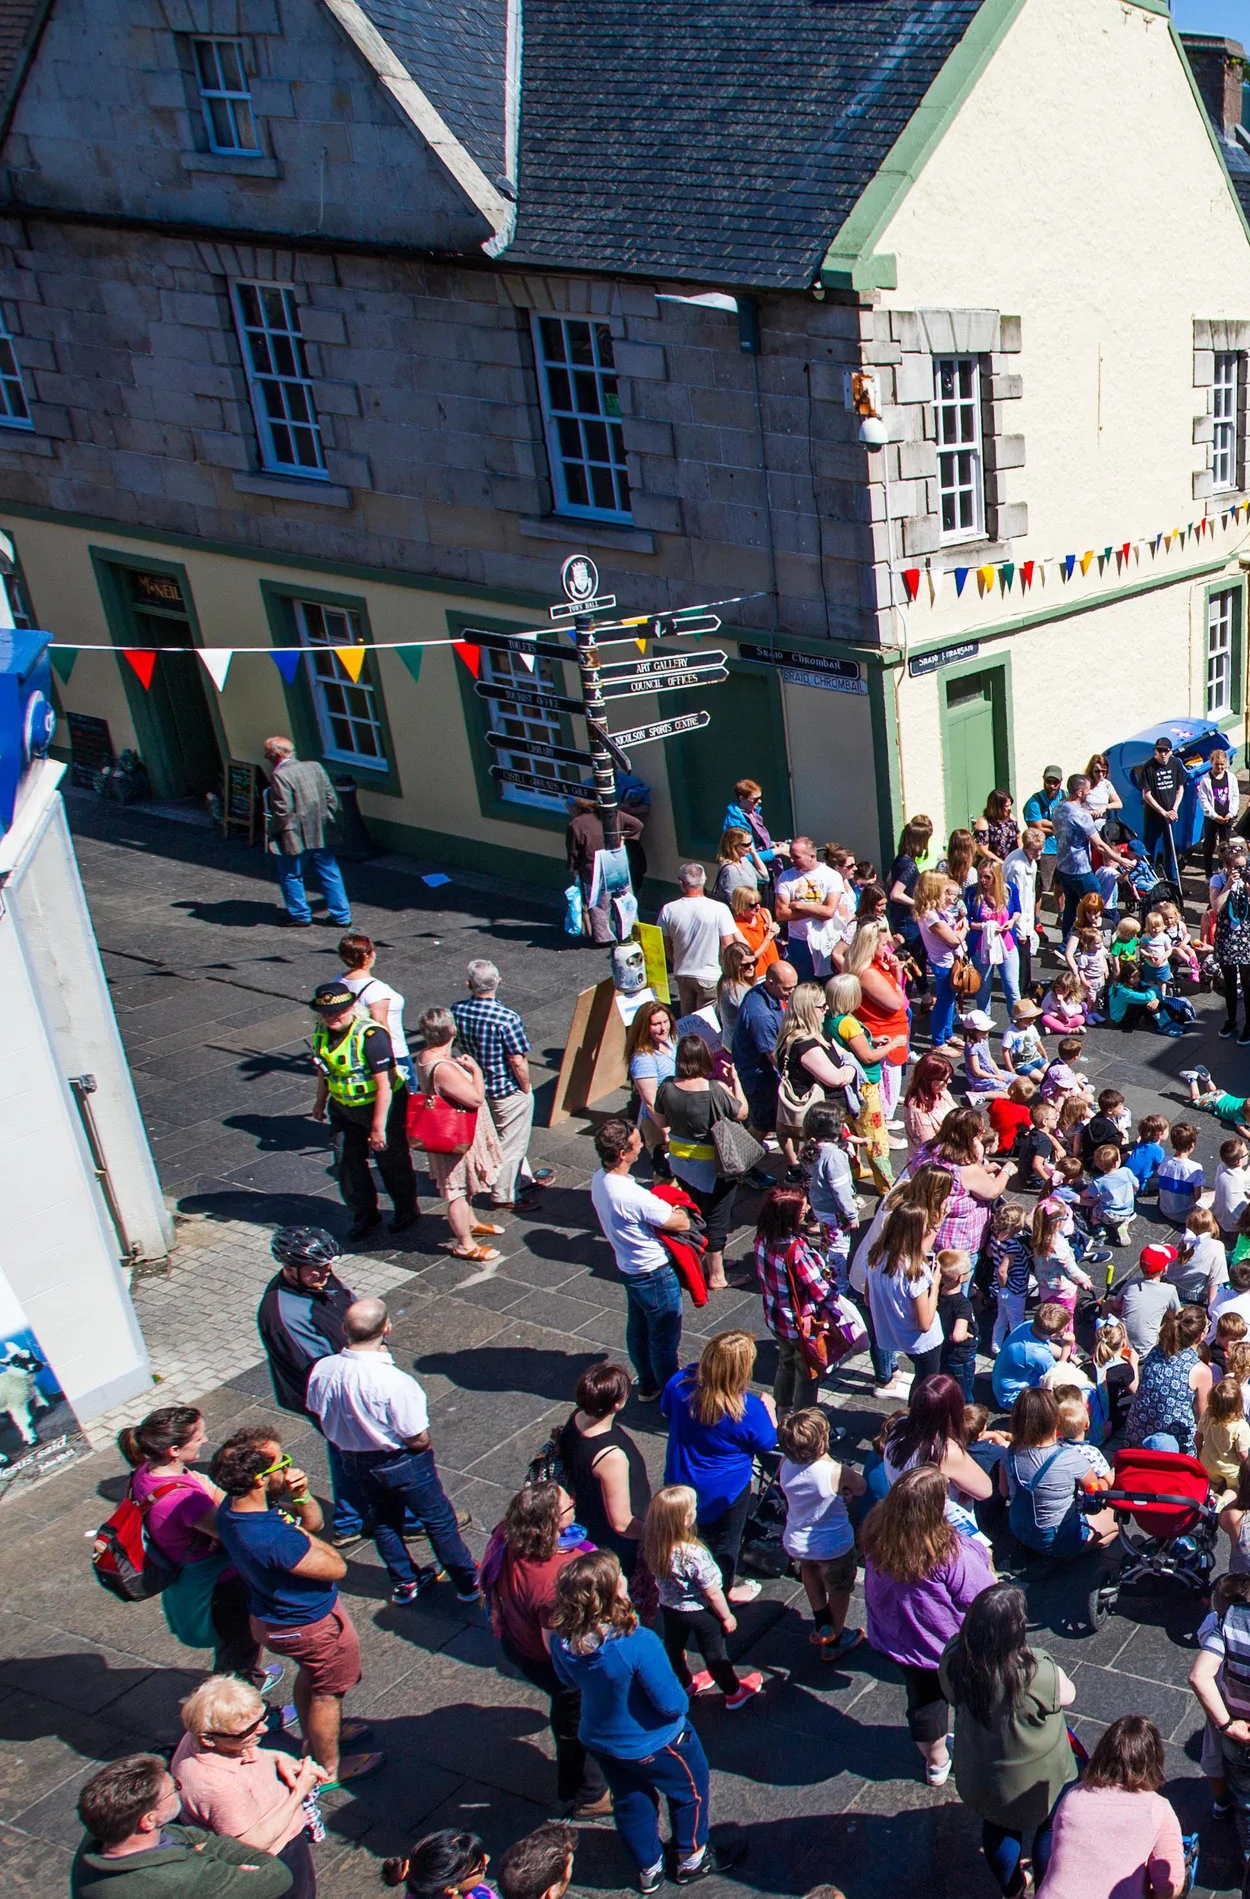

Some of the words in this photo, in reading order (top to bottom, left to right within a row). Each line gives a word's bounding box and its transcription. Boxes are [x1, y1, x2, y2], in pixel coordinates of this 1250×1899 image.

[508, 640, 537, 653] TOILETS
[636, 662, 651, 674] ART
[653, 658, 688, 671] GALLERY
[630, 679, 664, 692] COUNCIL
[667, 673, 698, 687] OFFICES
[814, 675, 865, 693] CHROMBAIL
[505, 690, 533, 704] TOURIST
[614, 731, 646, 746] NICOLSON
[649, 723, 672, 737] SPORTS
[675, 716, 699, 730] CENTRE
[527, 743, 555, 757] LIBRARY
[36, 1434, 67, 1459] said
